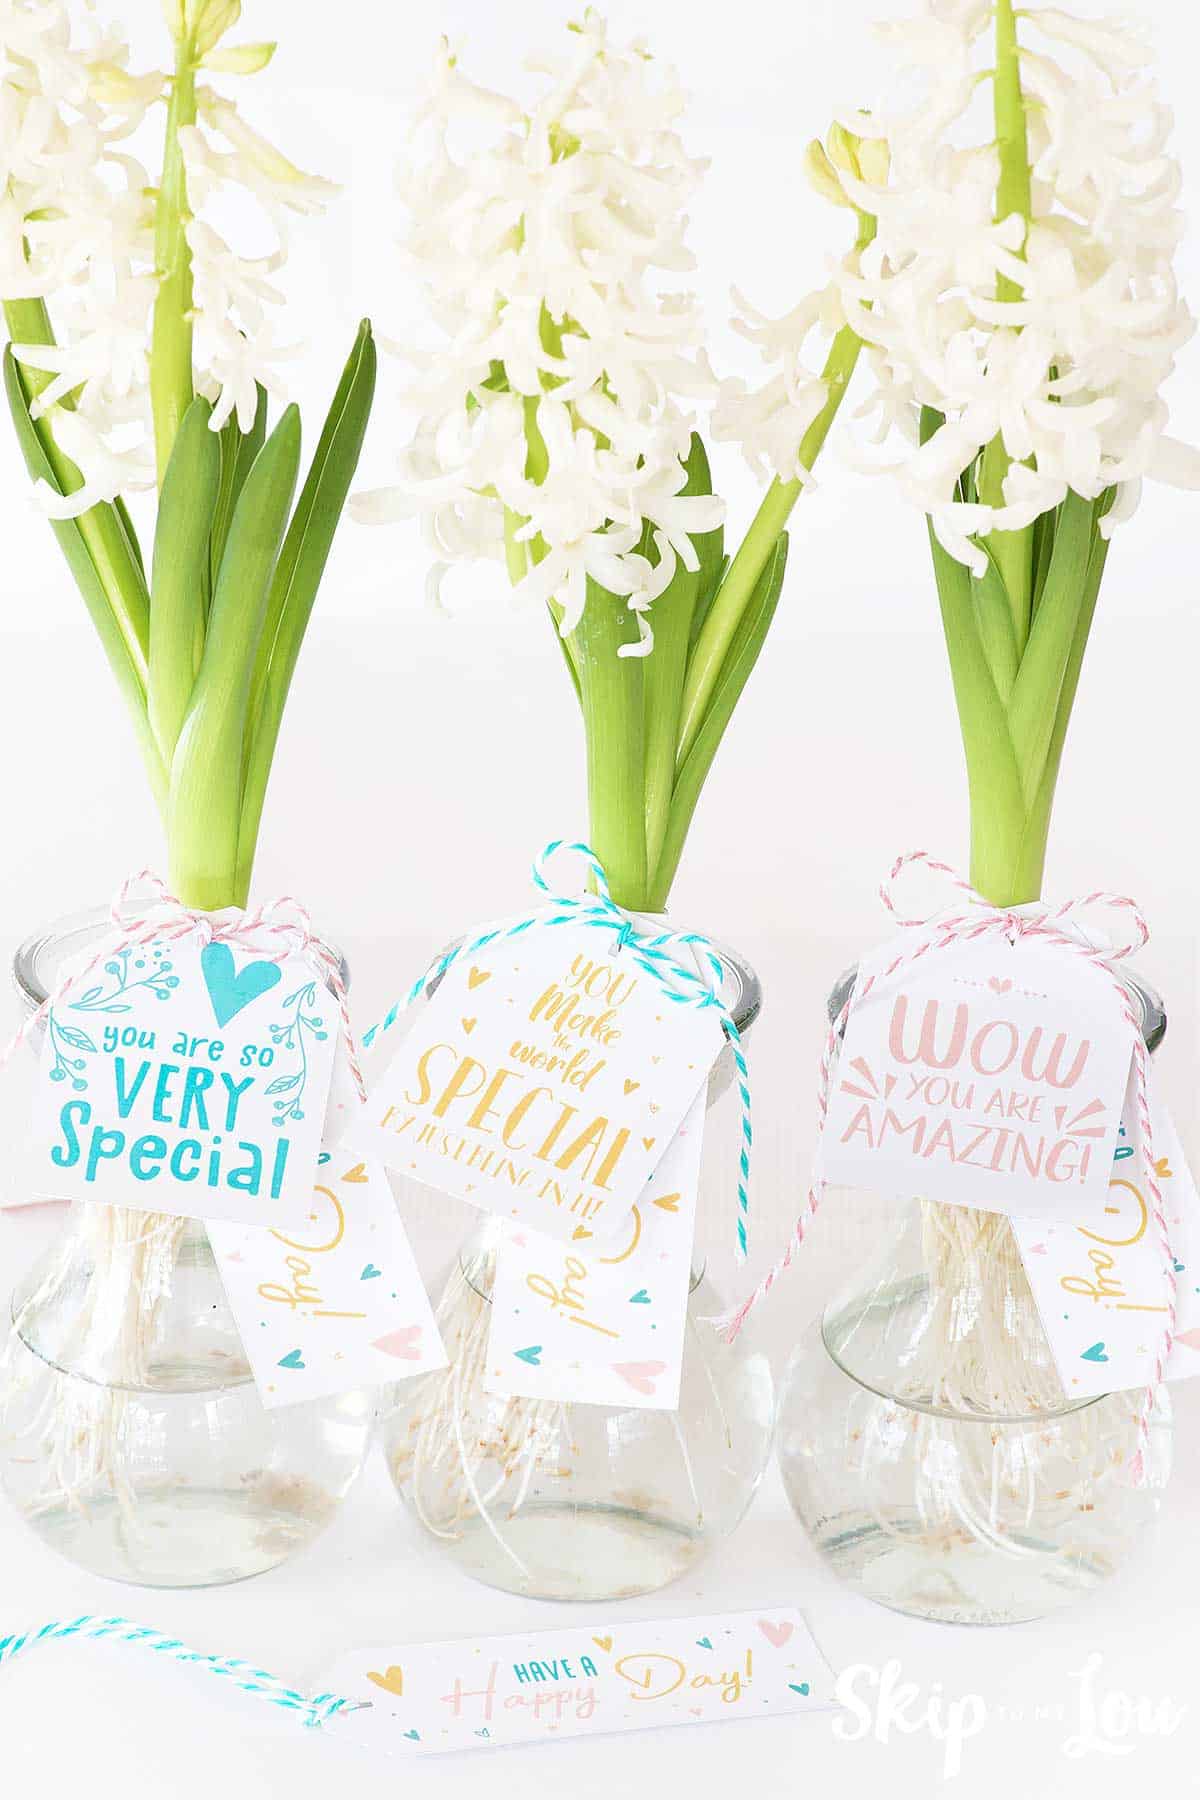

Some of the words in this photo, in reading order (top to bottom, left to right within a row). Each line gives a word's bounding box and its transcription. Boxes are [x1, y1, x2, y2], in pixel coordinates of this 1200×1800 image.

[102, 1025, 156, 1058] you
[171, 1031, 225, 1062] are
[240, 1044, 276, 1068] so
[529, 983, 622, 1046] Make
[552, 1032, 573, 1052] the
[888, 995, 1090, 1089] WOW
[114, 1056, 256, 1133] VERY
[509, 1040, 607, 1093] world
[905, 1074, 975, 1110] YOU
[985, 1088, 1045, 1124] ARE
[50, 1100, 290, 1200] Special
[405, 1044, 631, 1191] SPECIAL
[840, 1110, 1093, 1185] AMAZING!
[440, 1661, 601, 1720] Happy
[614, 1648, 753, 1703] Day!
[513, 1658, 577, 1684] HAVE
[580, 1655, 598, 1677] A
